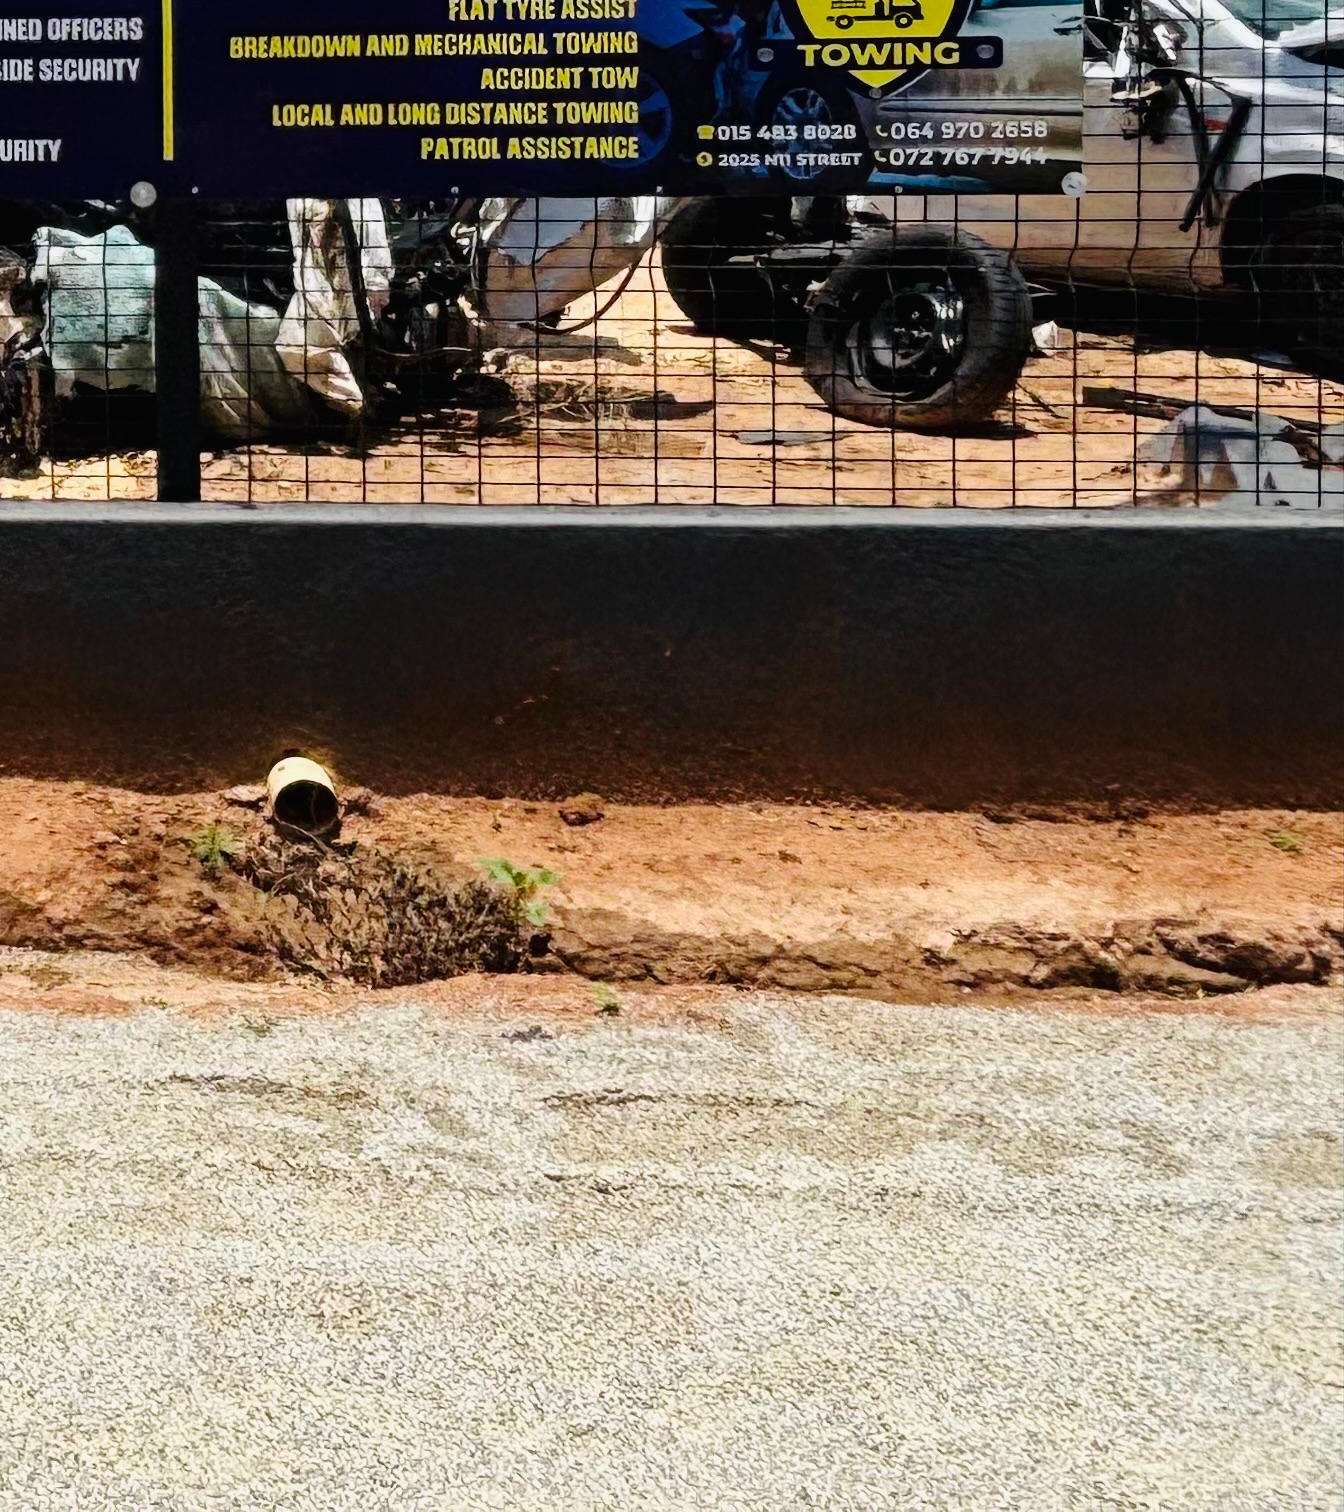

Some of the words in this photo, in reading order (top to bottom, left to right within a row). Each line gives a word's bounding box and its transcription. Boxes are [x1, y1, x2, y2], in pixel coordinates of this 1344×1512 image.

[47, 17, 144, 41] OFFICERS
[229, 35, 362, 59] BREAKDOWN
[365, 34, 410, 57] AND
[414, 33, 548, 56] MECHANICAL
[552, 31, 639, 54] TOWING
[796, 42, 961, 67] TOWING
[38, 58, 140, 82] SECURITY
[480, 68, 584, 90] ACCIDENT
[588, 67, 640, 89] TOW
[272, 104, 335, 127] LOCAL
[339, 103, 383, 126] AND
[387, 103, 441, 126] LONG
[445, 102, 548, 125] DISTANCE
[552, 101, 640, 124] TOWING
[717, 125, 752, 141] 015
[756, 125, 798, 141] 483
[803, 124, 857, 140] 8028
[890, 122, 934, 139] 064
[941, 121, 984, 138] 970
[991, 120, 1048, 138] 2658
[420, 138, 501, 160] PATROL
[506, 137, 640, 159] ASSISTANCE
[717, 153, 760, 167] 2025
[796, 152, 863, 166] STREET
[889, 148, 934, 166] 072
